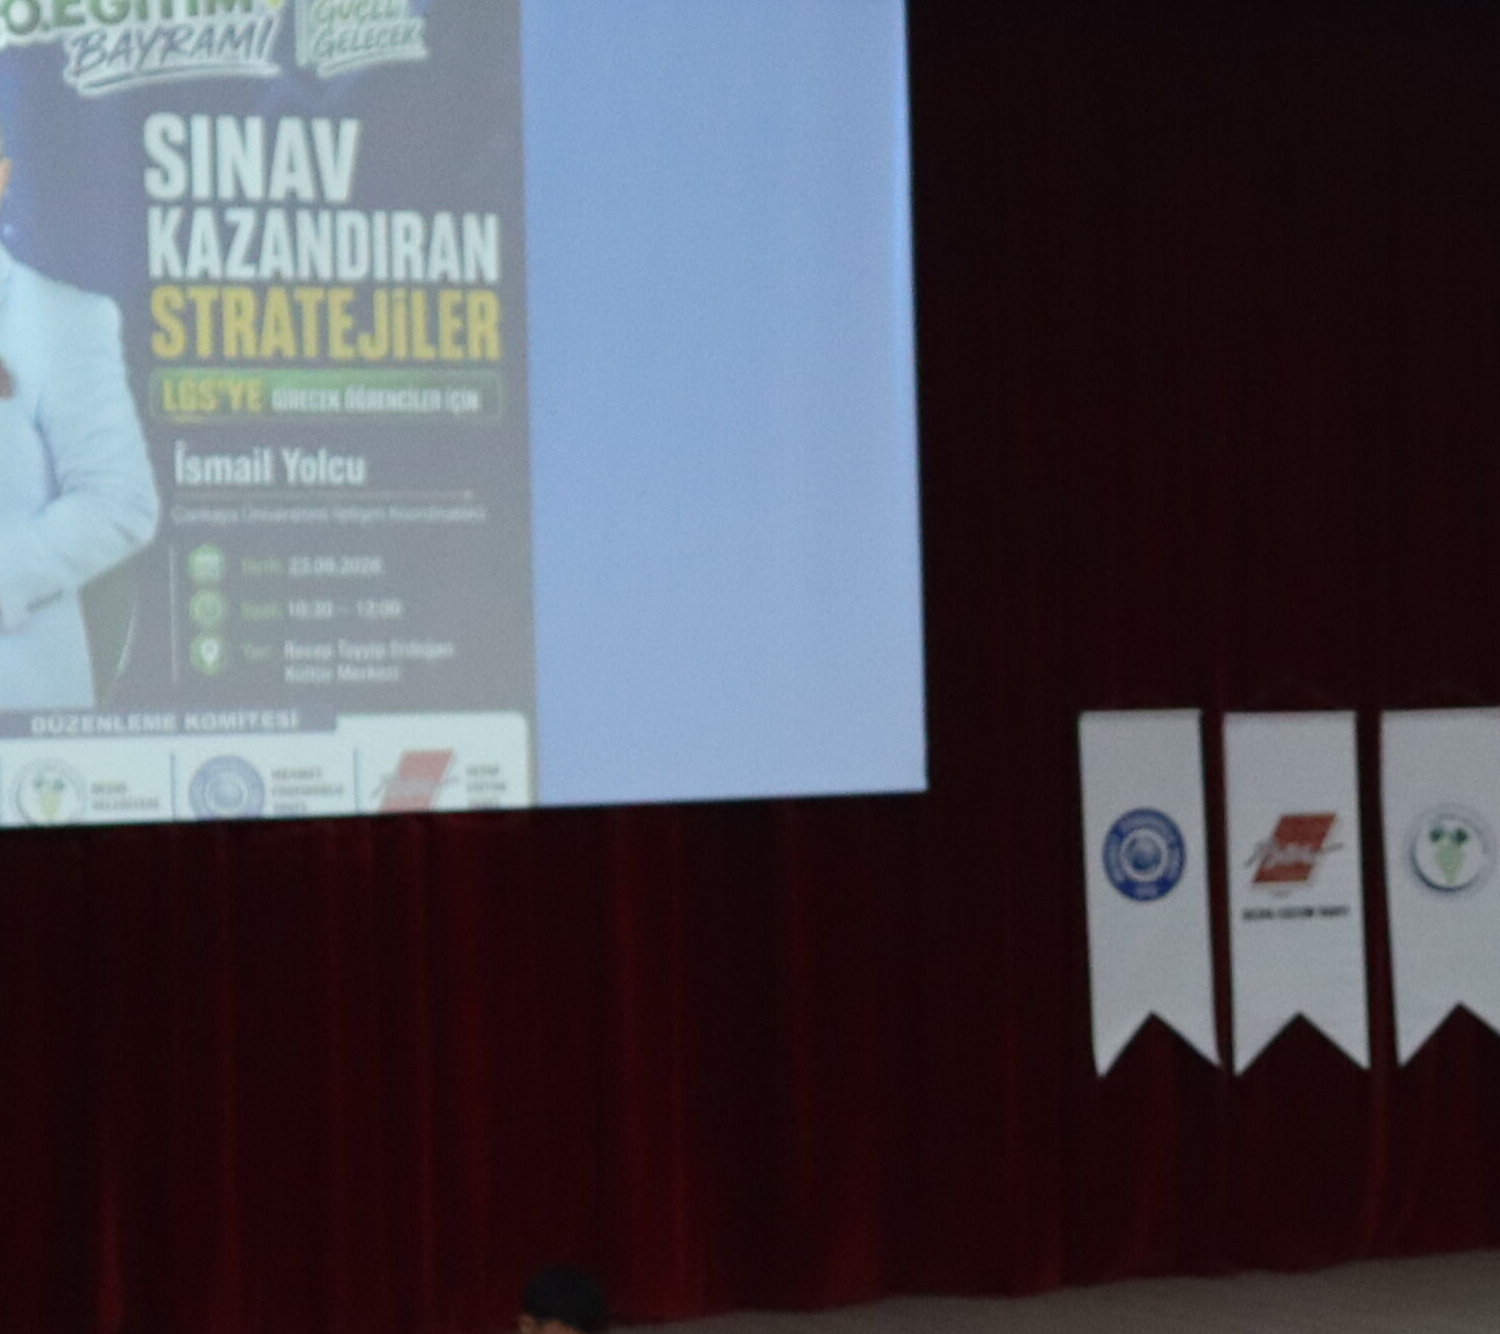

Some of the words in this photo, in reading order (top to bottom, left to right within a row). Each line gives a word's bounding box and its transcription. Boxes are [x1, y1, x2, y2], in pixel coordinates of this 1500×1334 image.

[71, 17, 275, 68] BAYRAMI
[143, 112, 359, 203] SINAV
[148, 206, 499, 284] KAZANDIRAN
[151, 285, 502, 360] STRATEJİLER
[174, 439, 273, 485] İsmail
[282, 447, 367, 485] Yolcu
[30, 712, 179, 735] DÜZENLEME
